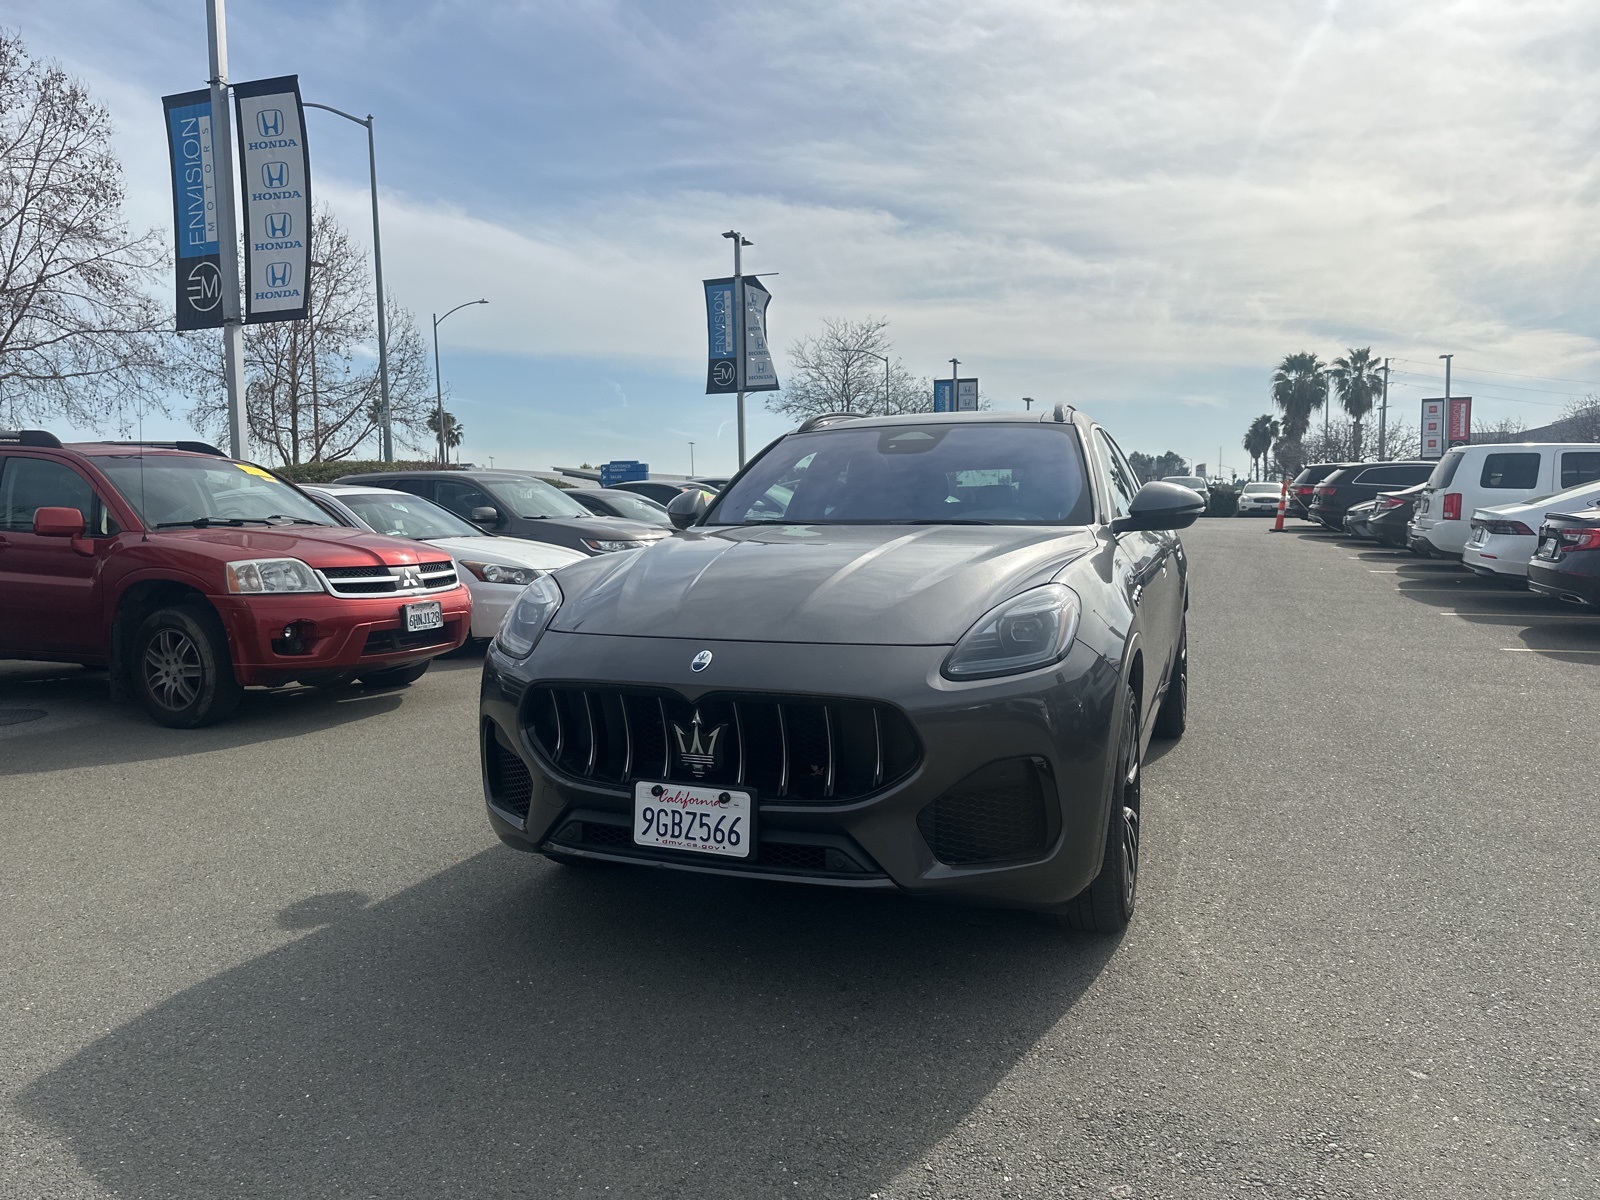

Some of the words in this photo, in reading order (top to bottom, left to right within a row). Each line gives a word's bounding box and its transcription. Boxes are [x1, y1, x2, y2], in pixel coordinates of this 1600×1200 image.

[248, 138, 298, 151] HONDA
[180, 117, 205, 246] ENVISION
[202, 127, 216, 232] MOTORS
[252, 190, 302, 202] HONDA
[254, 240, 303, 251] HONDA
[255, 289, 301, 301] HONDA
[713, 290, 726, 354] ENVISION
[410, 611, 440, 626] 6HNJ128
[657, 788, 729, 809] California
[641, 806, 742, 846] 9GBZ566
[661, 839, 720, 851] dmv.ca.gov
